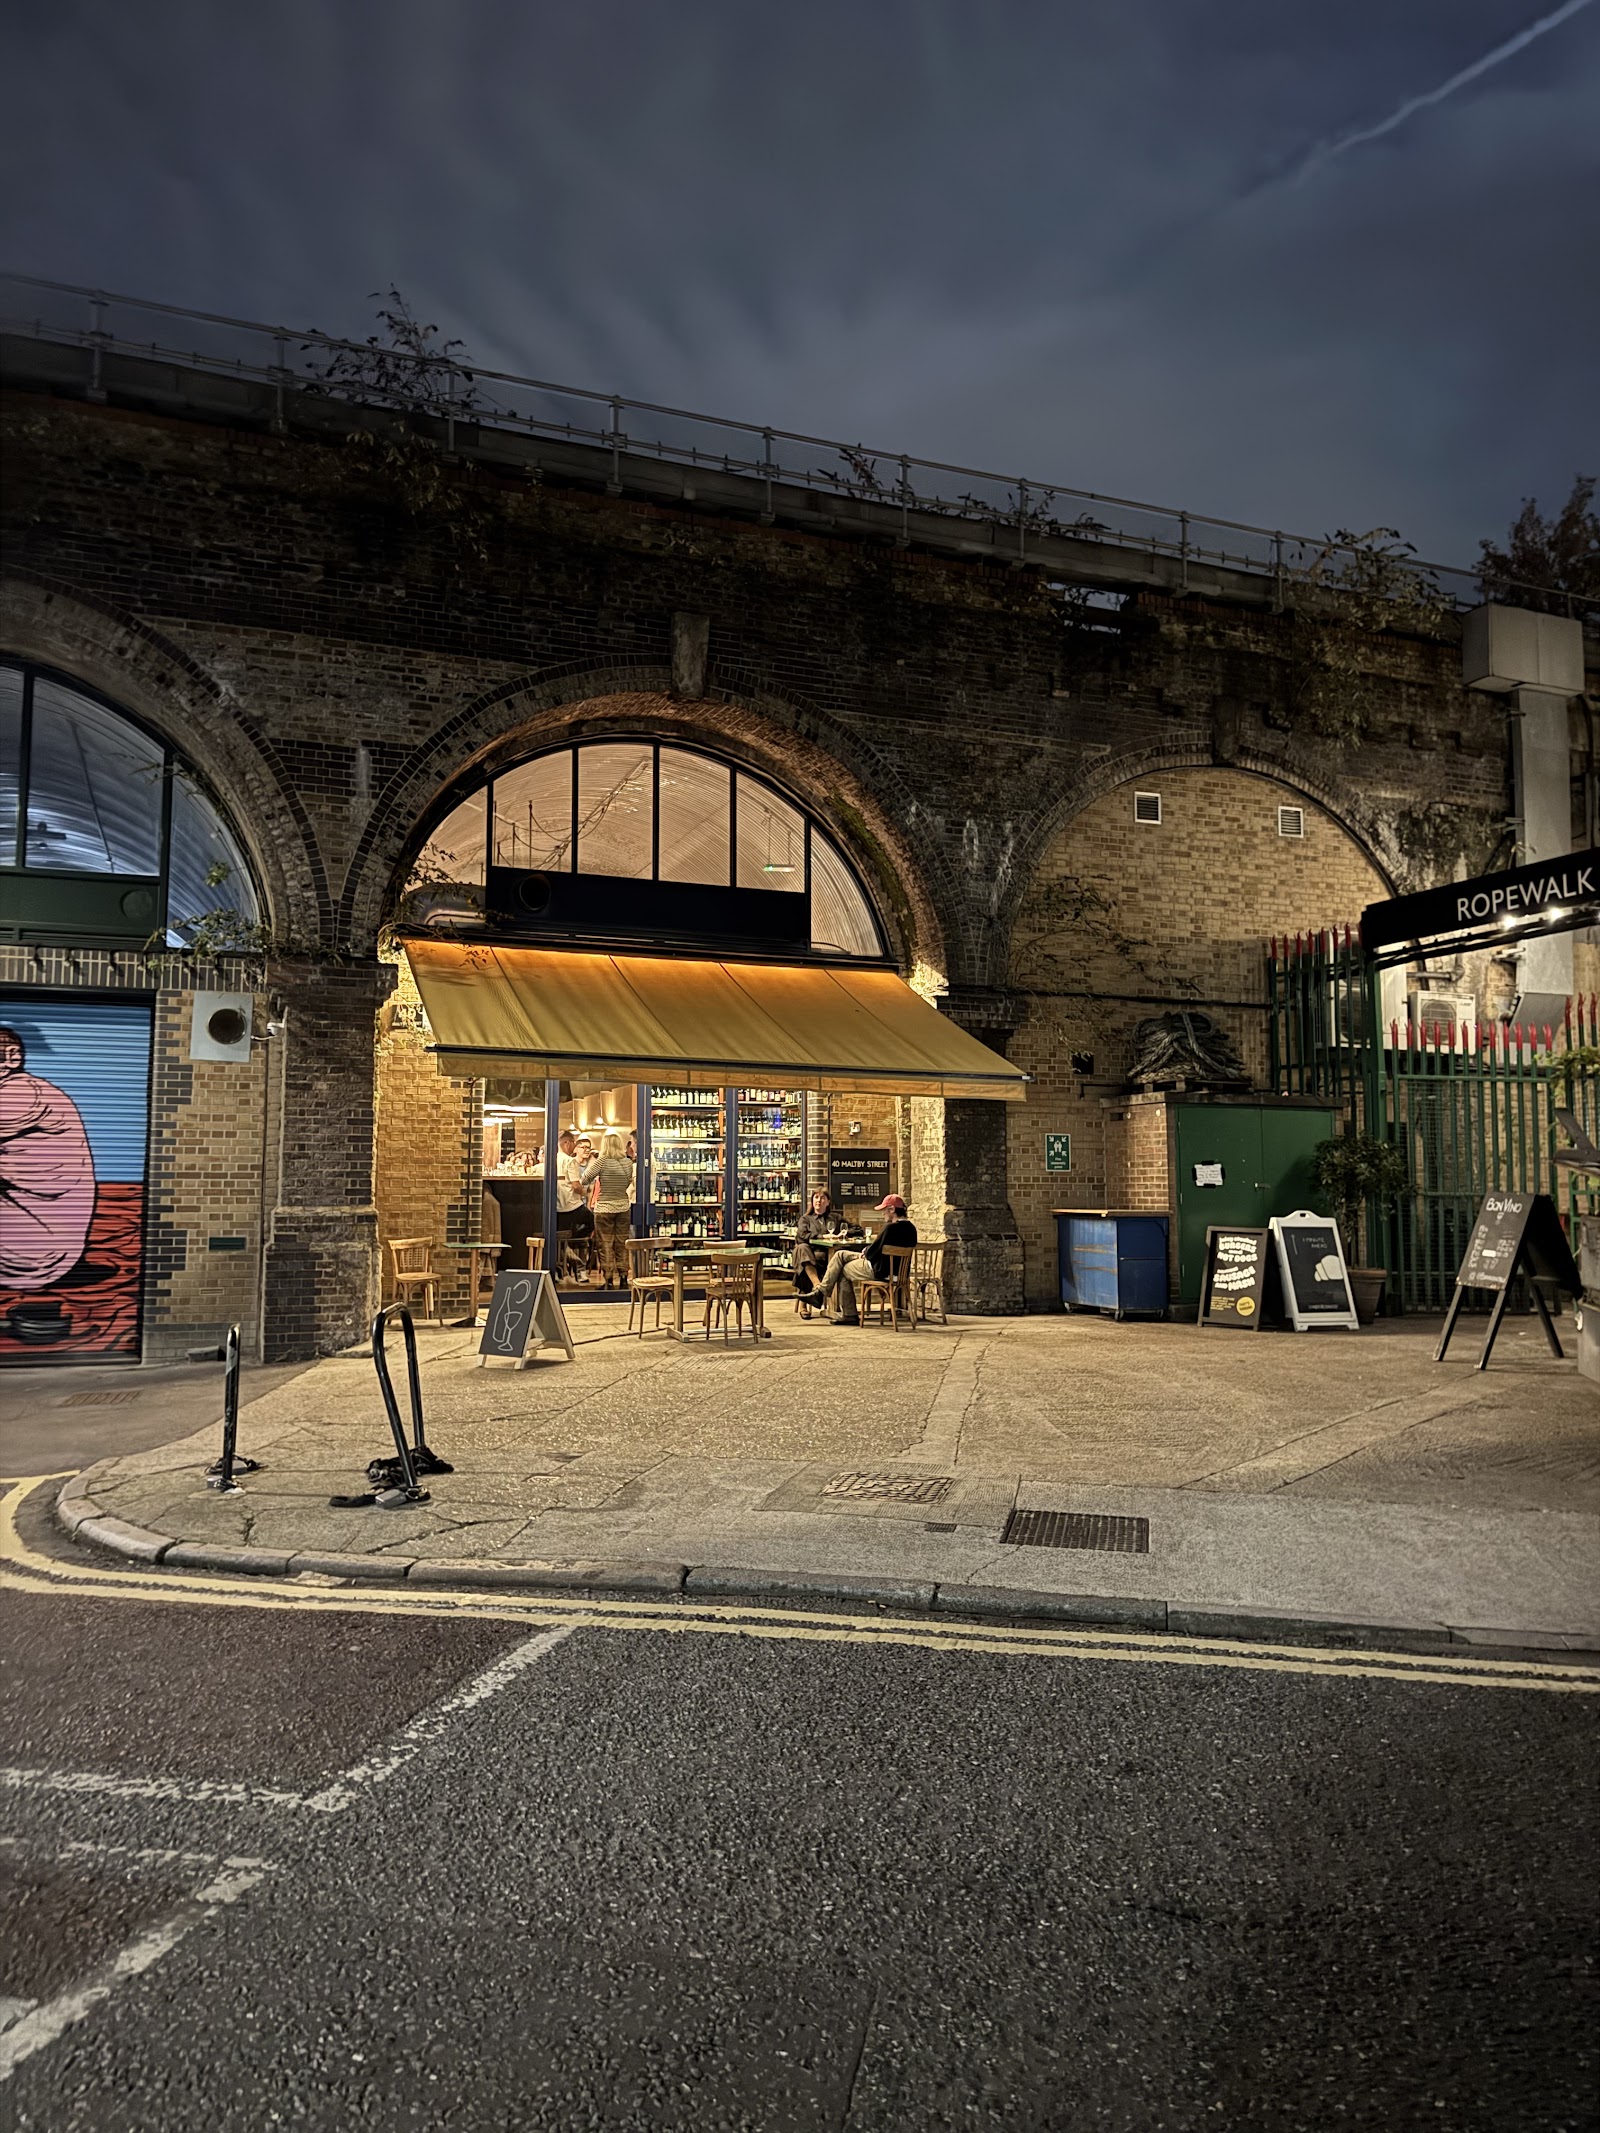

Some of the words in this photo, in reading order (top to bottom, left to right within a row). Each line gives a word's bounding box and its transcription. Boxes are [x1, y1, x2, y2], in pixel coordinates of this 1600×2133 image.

[1457, 867, 1596, 921] ROPEWALK
[831, 1160, 840, 1168] 40
[841, 1160, 865, 1168] MALTBY
[866, 1160, 888, 1168] STREET
[1219, 1242, 1257, 1254] BURGERS
[1217, 1251, 1234, 1262] HOT
[1234, 1253, 1258, 1263] DOGS
[1213, 1265, 1256, 1282] SAUSAGE
[1228, 1276, 1255, 1291] MASH
